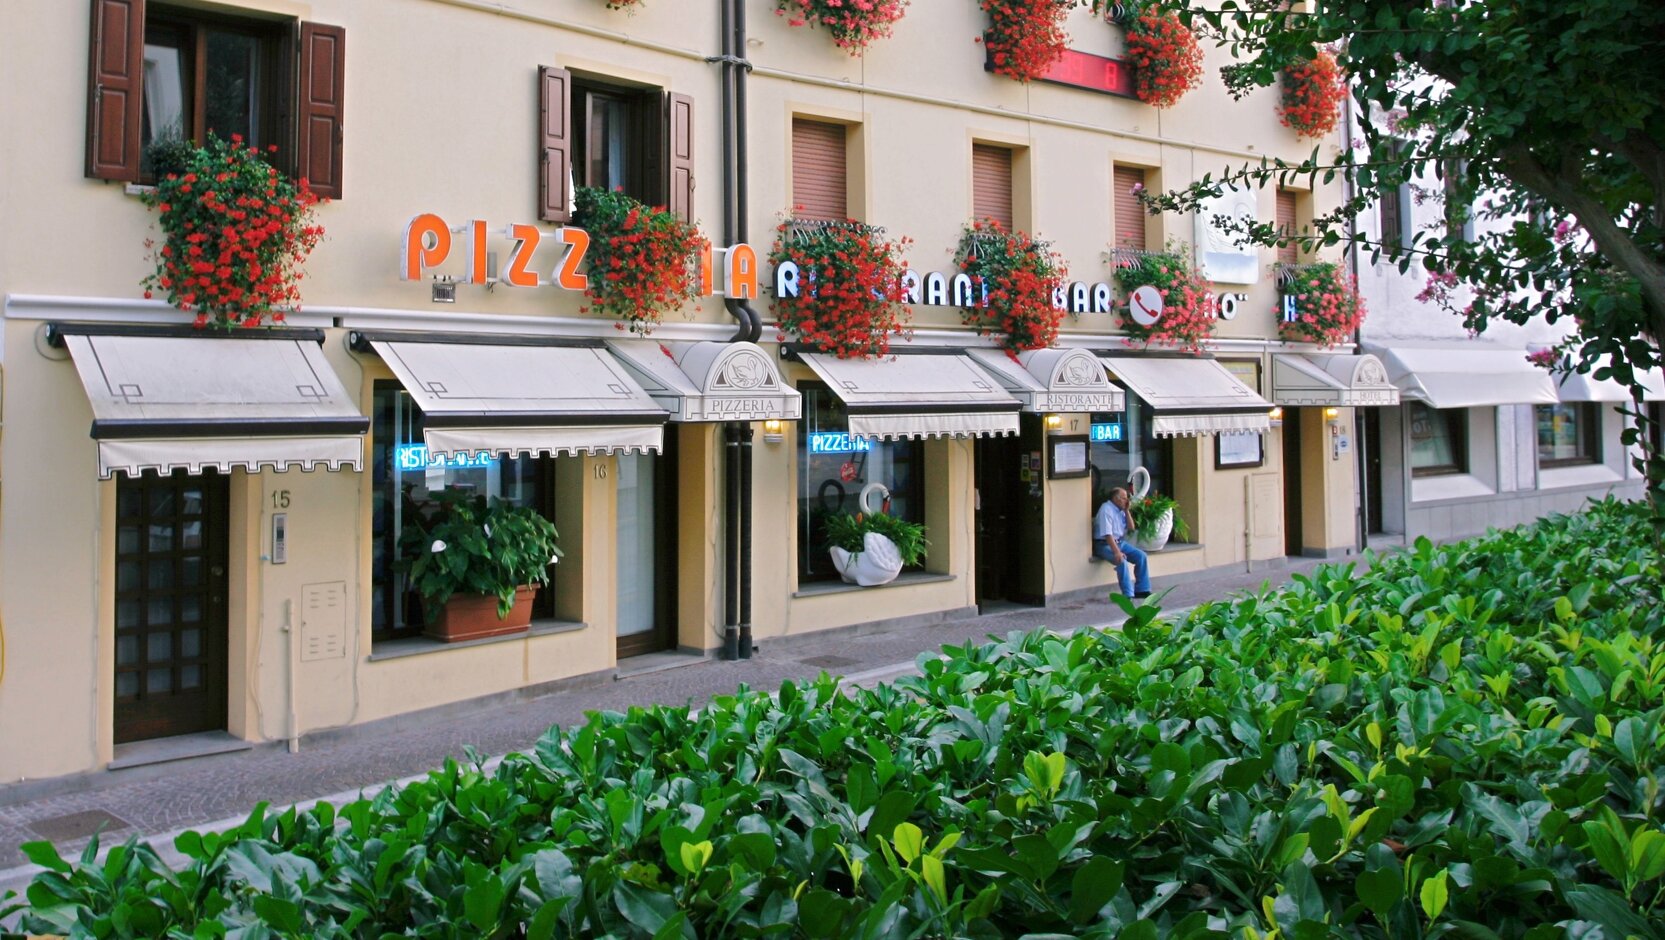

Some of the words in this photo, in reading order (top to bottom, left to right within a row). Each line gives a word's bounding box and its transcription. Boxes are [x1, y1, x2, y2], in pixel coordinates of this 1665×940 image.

[401, 212, 758, 299] PIZZIA
[1051, 280, 1110, 313] BAR
[1359, 391, 1381, 401] HOTEL
[711, 399, 775, 412] PIZZERIA
[1069, 419, 1079, 432] 17
[1097, 425, 1120, 440] BAR
[593, 464, 608, 479] 16
[271, 490, 290, 509] 15
